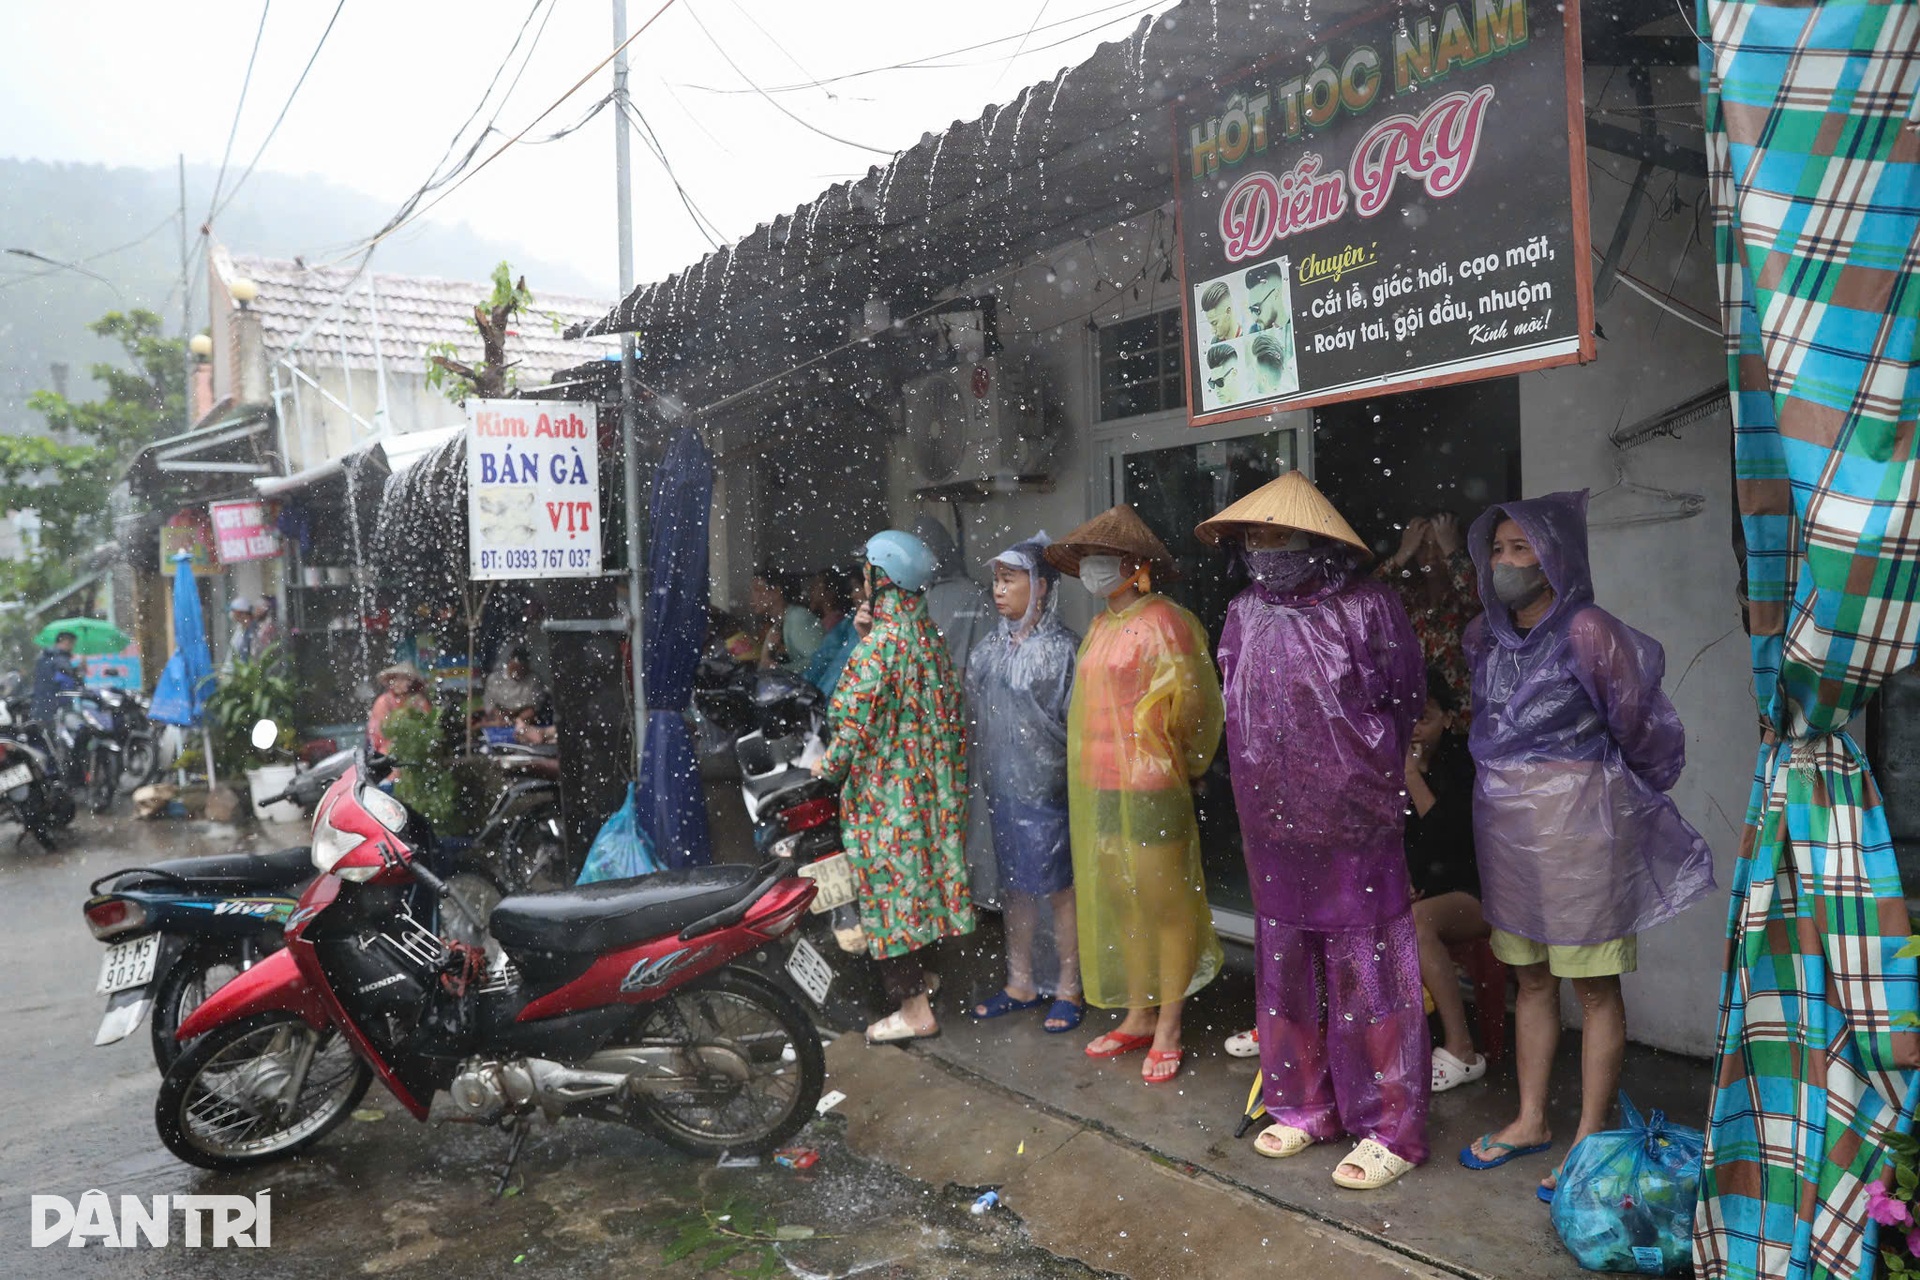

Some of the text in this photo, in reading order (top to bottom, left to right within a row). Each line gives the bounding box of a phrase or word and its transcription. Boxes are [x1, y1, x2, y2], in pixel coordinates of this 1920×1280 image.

[1279, 45, 1381, 140] TÓC
[1393, 0, 1528, 94] NAM
[1219, 155, 1348, 263] Diễm
[1311, 288, 1342, 319] Cắt
[1346, 282, 1368, 310] lễ,
[1372, 273, 1413, 308] giác
[1418, 261, 1454, 290] hơi,
[1459, 253, 1500, 281] cạo
[1506, 234, 1555, 267] mặt,
[1314, 325, 1356, 354] Roáy
[1360, 317, 1390, 342] tai,
[1394, 309, 1424, 341] gội
[1429, 293, 1473, 326] đầu,
[1479, 280, 1552, 315] nhuộm
[1468, 319, 1509, 345] Kính
[476, 411, 588, 439] Kim Anh
[480, 443, 588, 485] BÁN GÀ
[546, 501, 593, 540] VỊT
[481, 549, 591, 570] ĐT: 0393 767 037
[213, 900, 274, 915] Viva
[104, 960, 147, 990] 9032
[359, 973, 407, 993] HONDA
